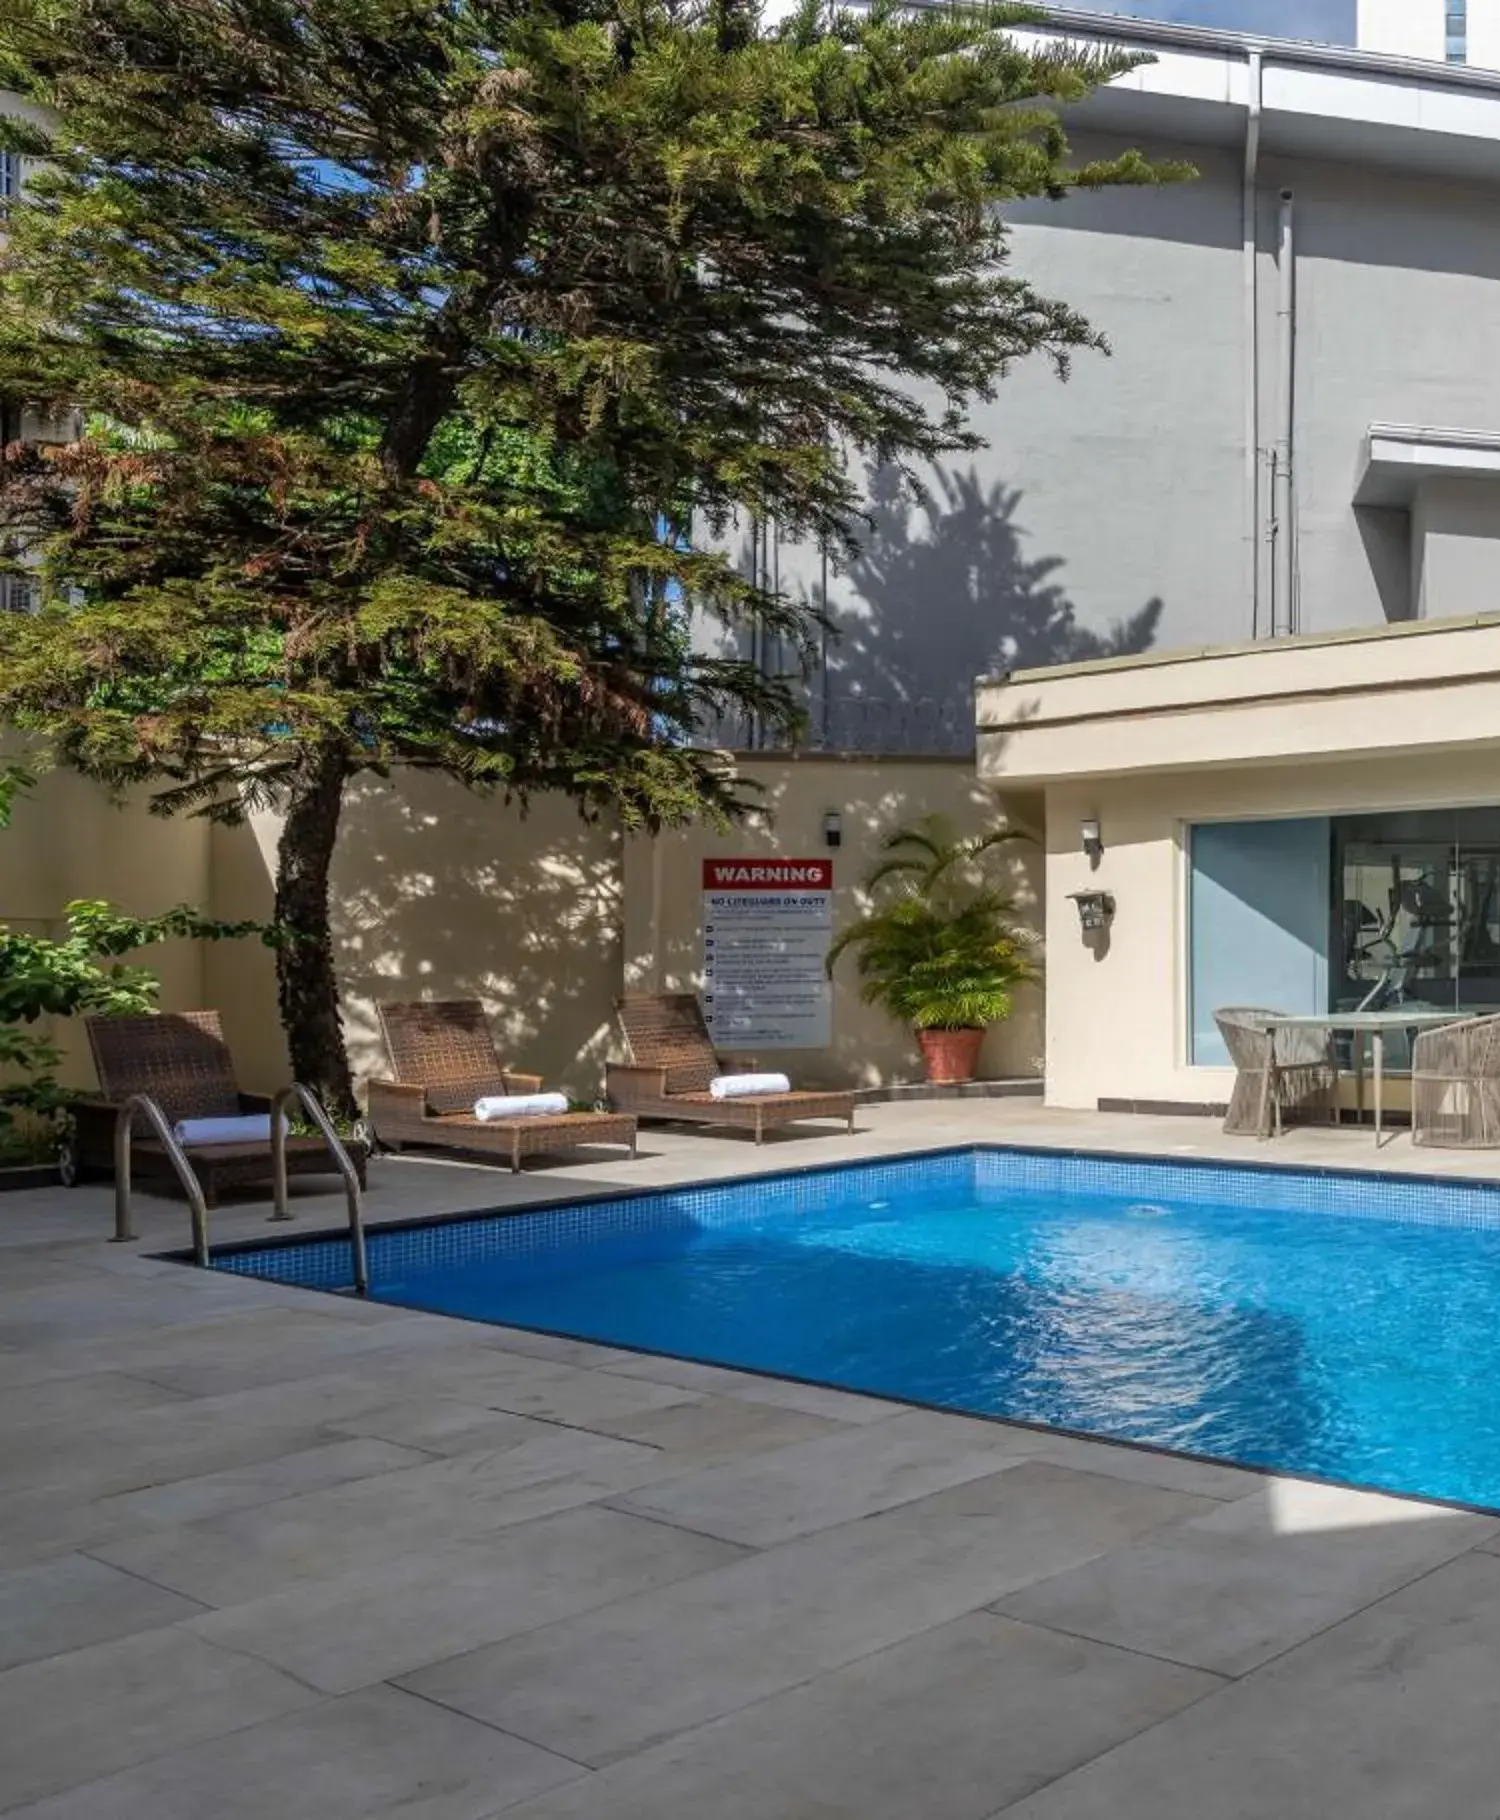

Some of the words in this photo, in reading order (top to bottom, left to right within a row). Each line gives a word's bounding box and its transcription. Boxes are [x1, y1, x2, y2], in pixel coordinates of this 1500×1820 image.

[714, 867, 823, 882] WARNING
[712, 897, 725, 905] NO
[783, 897, 798, 905] ON
